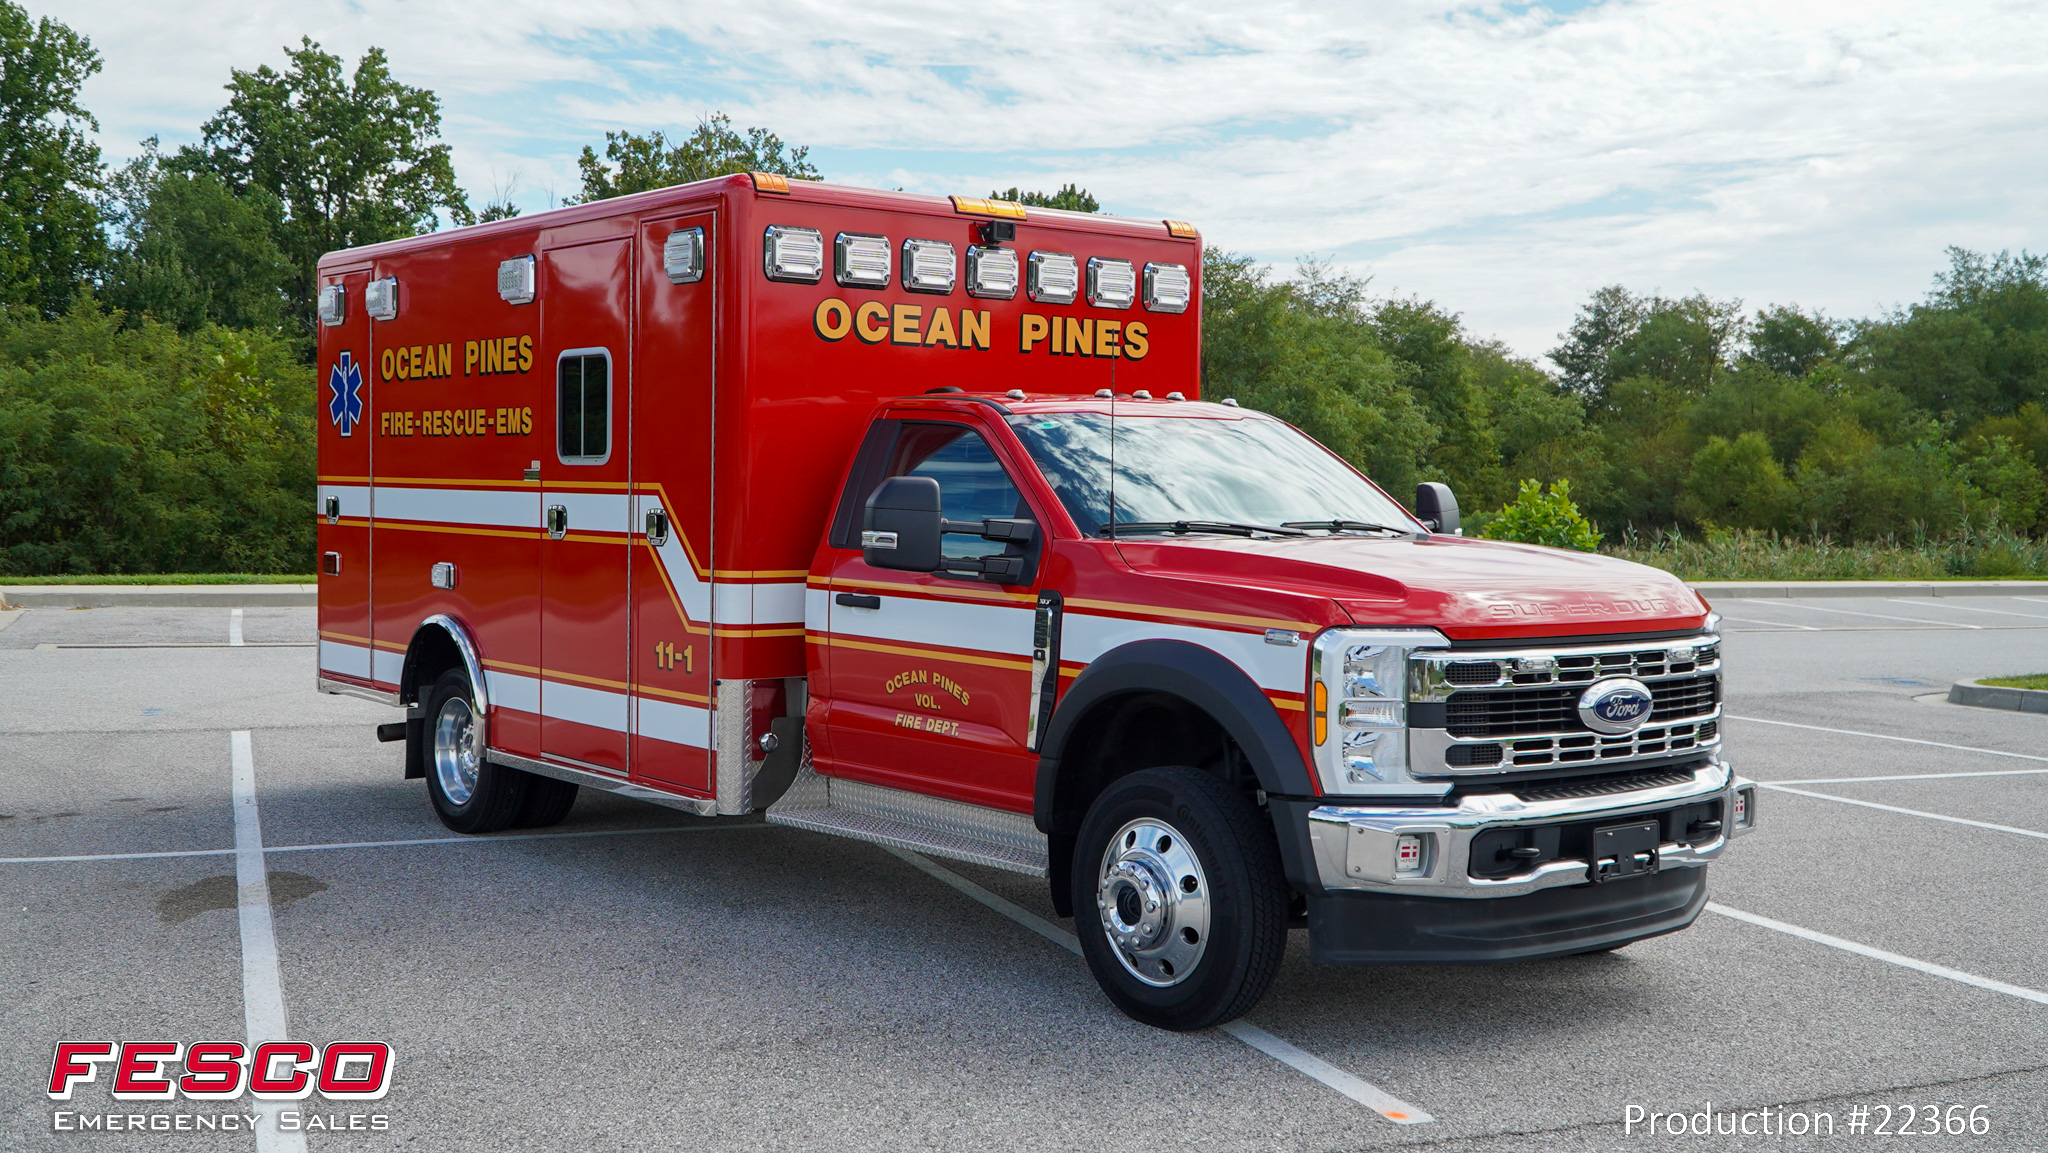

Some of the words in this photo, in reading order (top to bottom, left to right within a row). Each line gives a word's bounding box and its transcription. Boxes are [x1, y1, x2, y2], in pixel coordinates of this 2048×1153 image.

[813, 297, 991, 352] OCEAN
[1019, 312, 1150, 361] PINES
[381, 342, 452, 383] OCEAN
[465, 334, 533, 376] PINES
[381, 406, 533, 437] FIRE-RESCUE-EMS
[1488, 602, 1609, 619] SUPER
[1612, 597, 1684, 615] DUTY
[654, 640, 693, 675] 11-1
[885, 669, 928, 694] OCEAN
[932, 671, 970, 706] PINES
[914, 693, 941, 710] VOL.
[1606, 694, 1640, 718] Ford
[894, 713, 923, 730] FIRE
[925, 718, 959, 737] DEPT.
[1177, 803, 1226, 890] Continental
